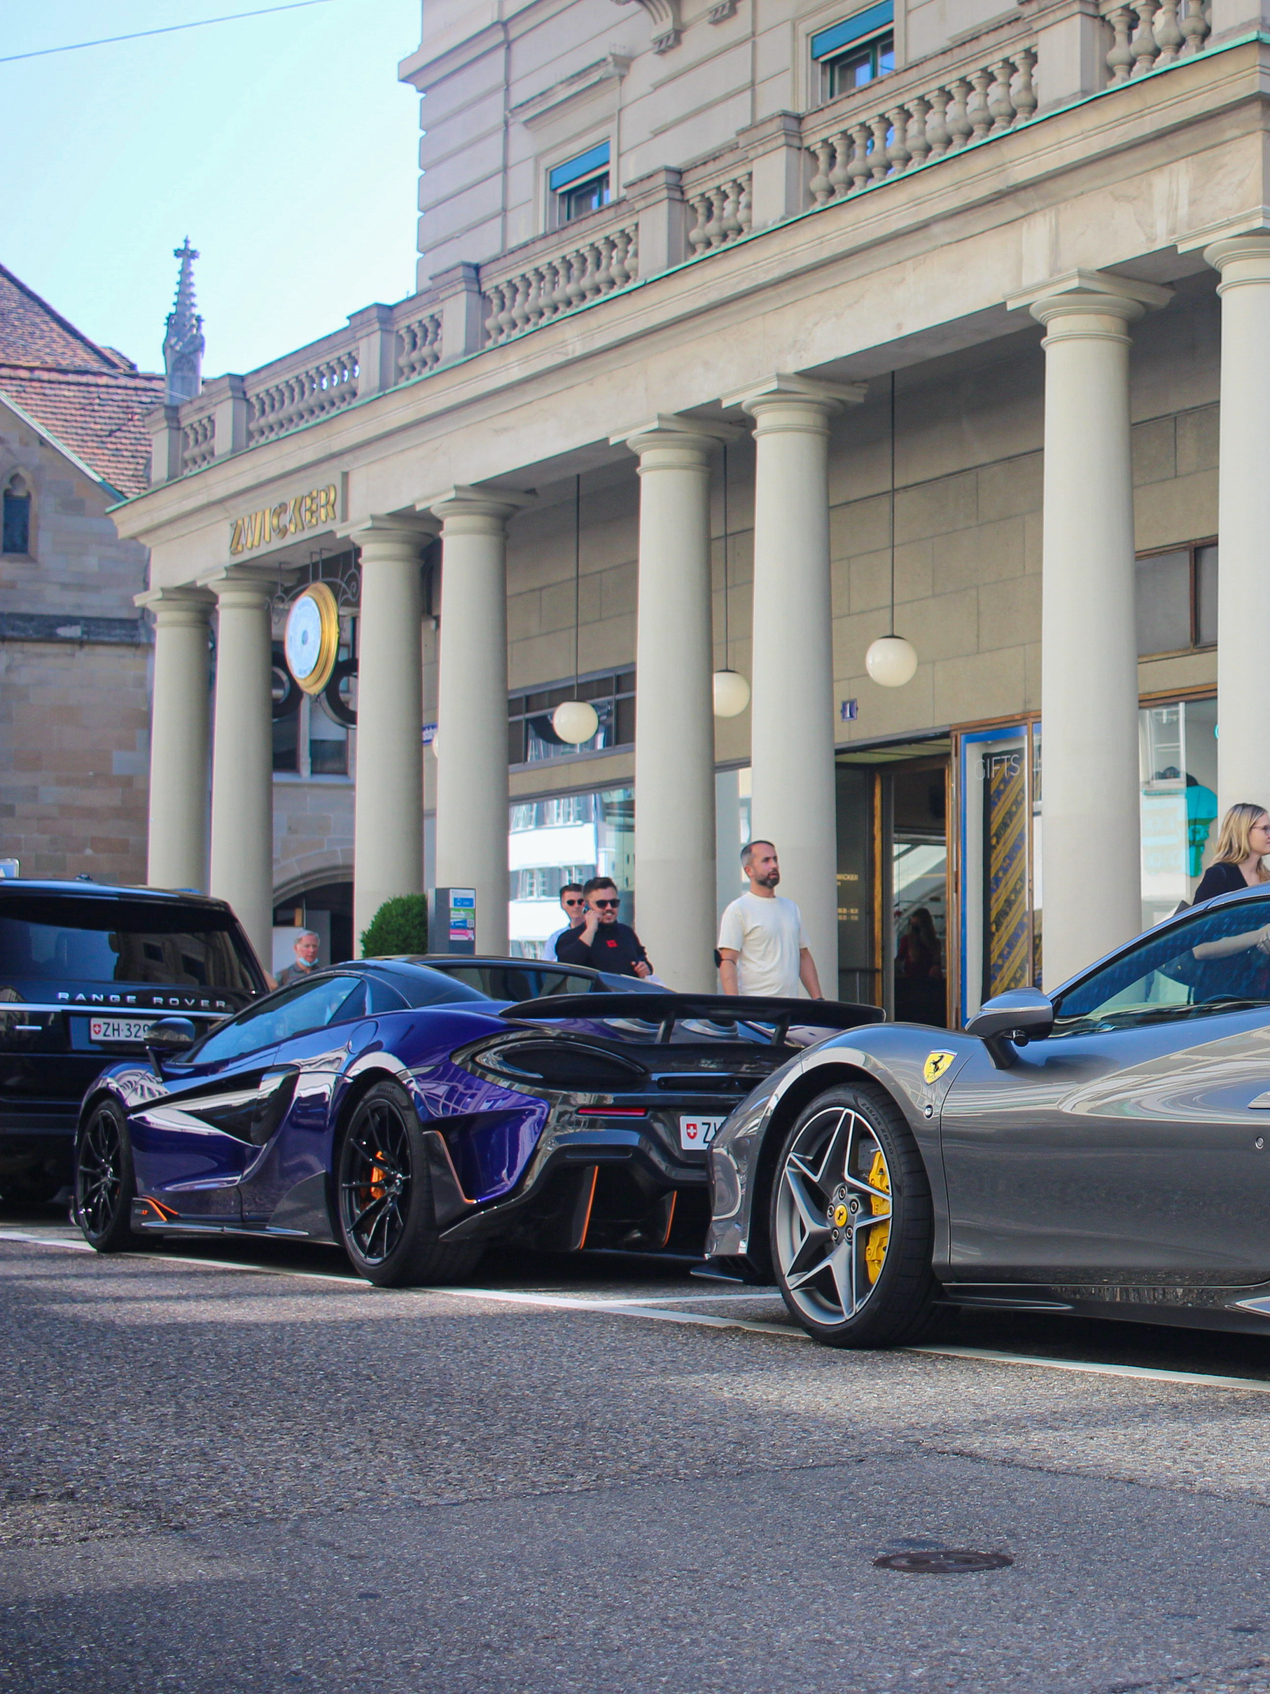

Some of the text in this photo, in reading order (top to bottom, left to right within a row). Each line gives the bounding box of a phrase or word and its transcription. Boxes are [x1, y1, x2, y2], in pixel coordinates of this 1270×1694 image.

[229, 484, 337, 555] ZWICKER
[974, 754, 1021, 781] GIFTS
[57, 991, 227, 1008] RANGE ROVER
